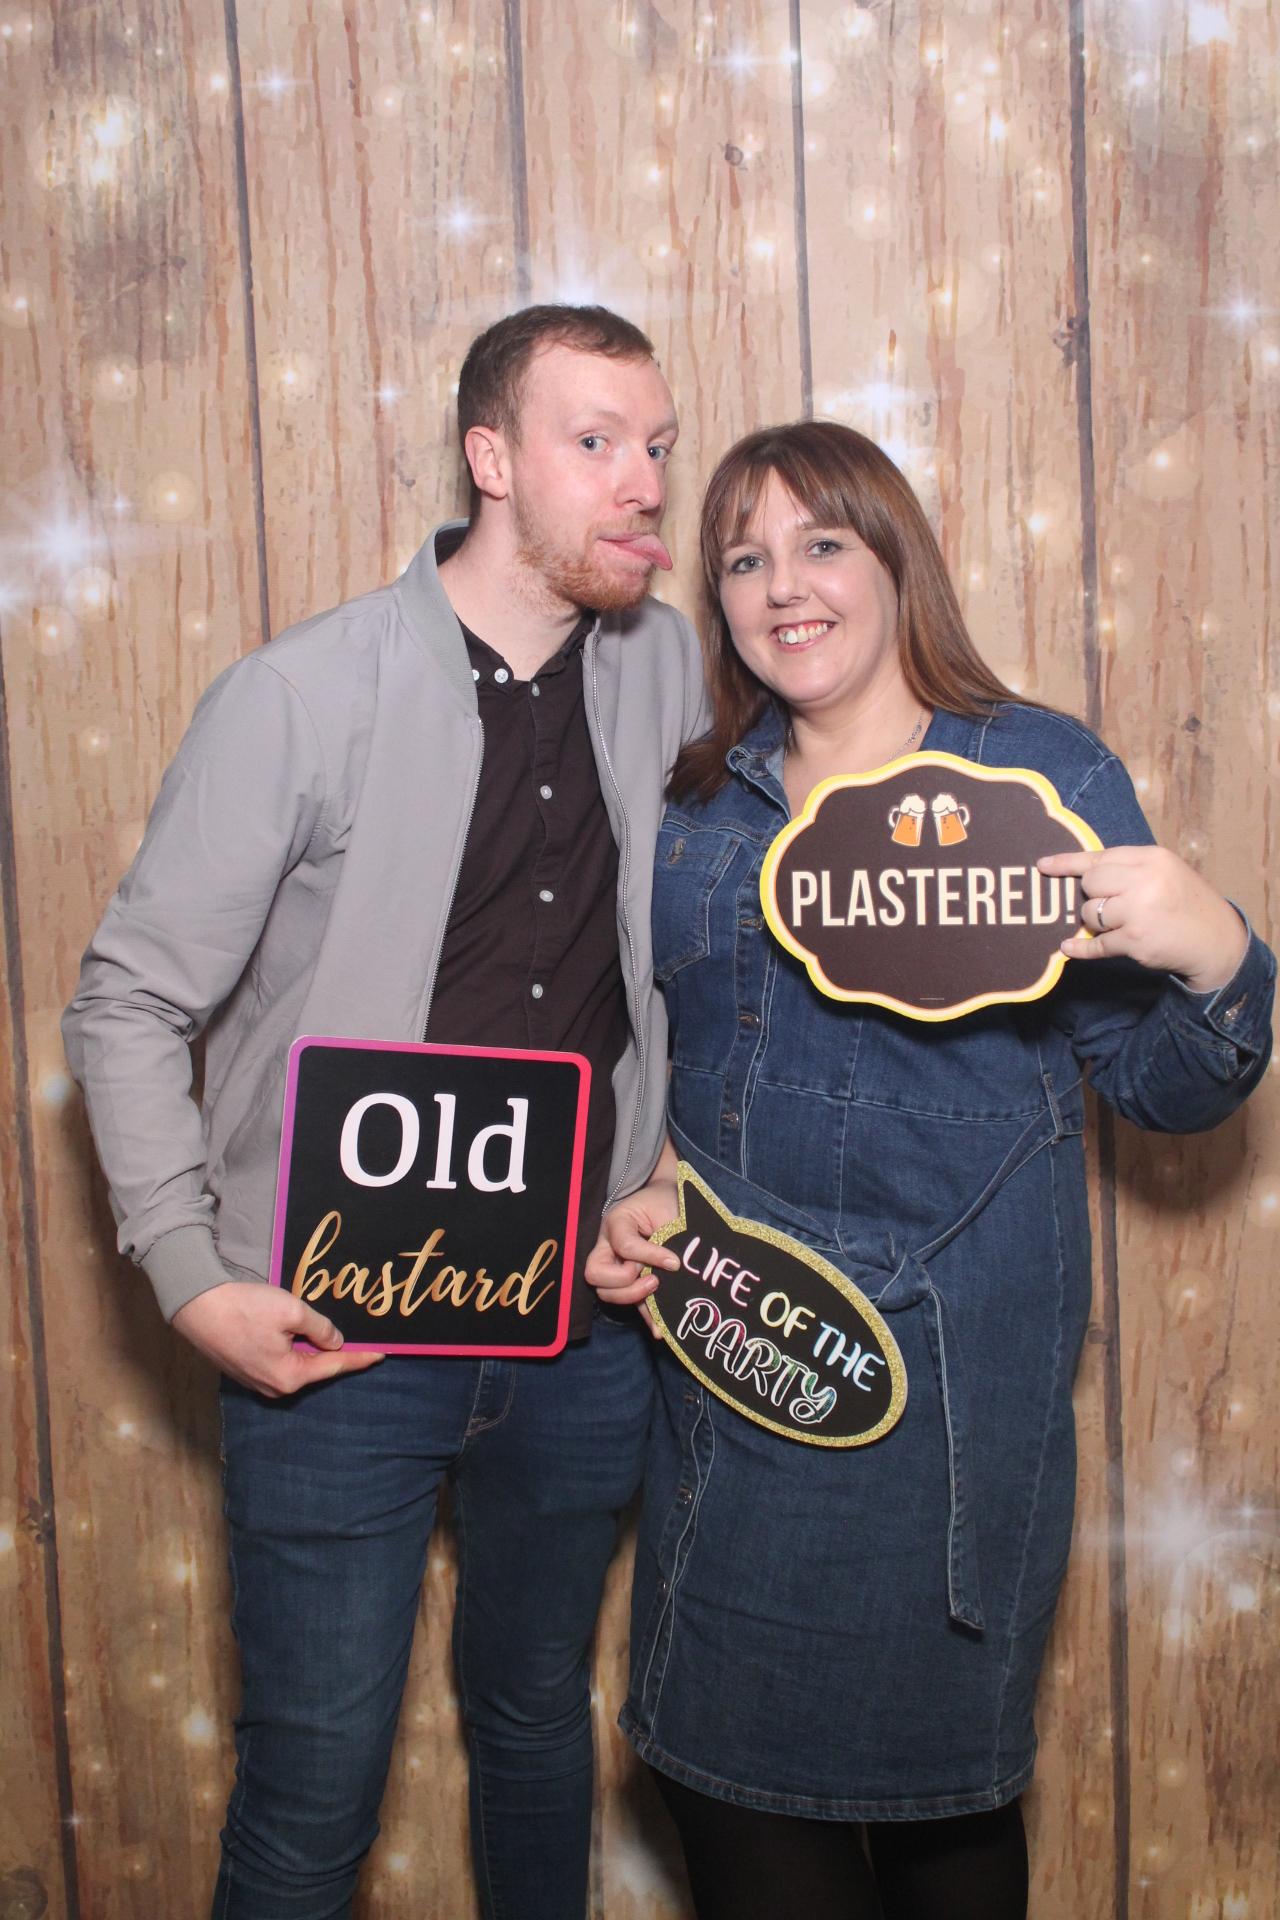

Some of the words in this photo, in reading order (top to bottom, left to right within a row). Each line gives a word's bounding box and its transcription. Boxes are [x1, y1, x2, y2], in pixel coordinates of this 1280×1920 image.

[790, 867, 1076, 927] PLASTERED!
[339, 1092, 530, 1193] Old
[291, 1210, 559, 1318] bastard
[682, 1236, 761, 1308] LIFE
[759, 1291, 816, 1338] OF
[812, 1321, 886, 1392] THE
